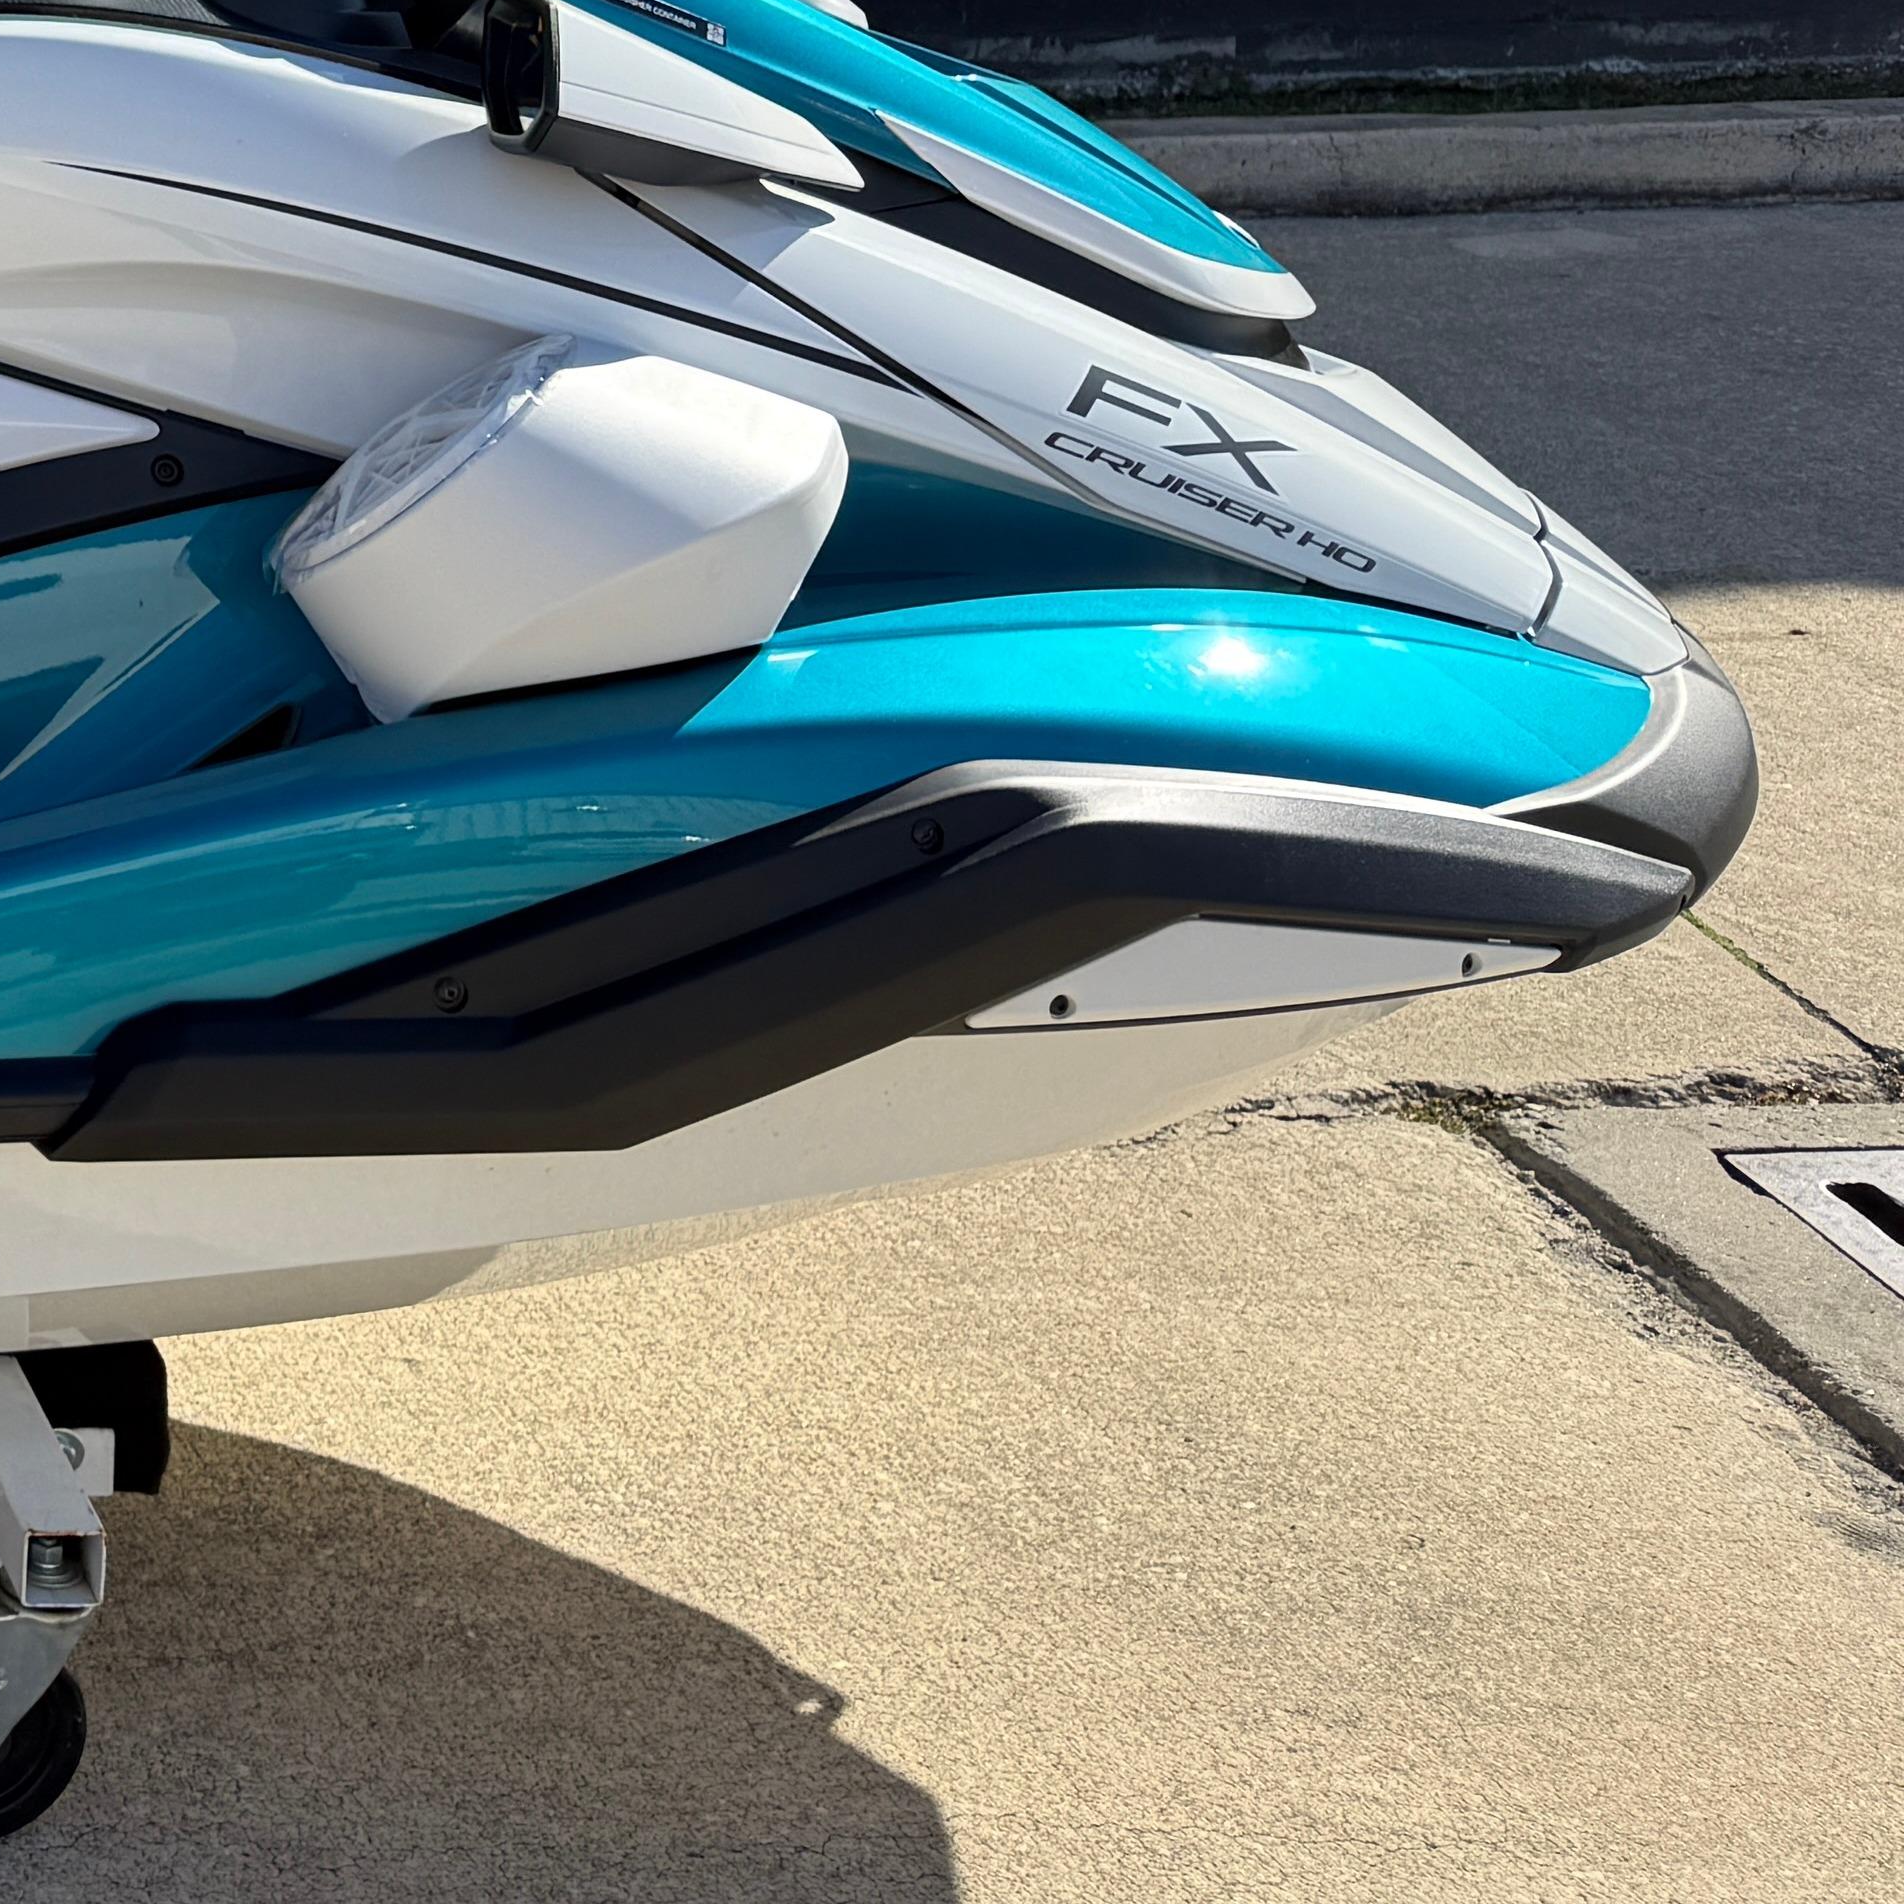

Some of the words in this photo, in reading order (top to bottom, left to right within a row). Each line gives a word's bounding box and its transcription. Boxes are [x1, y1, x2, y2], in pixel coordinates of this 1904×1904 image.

[1065, 364, 1298, 496] FX
[1043, 431, 1295, 539] CRUISER
[1294, 529, 1378, 574] HO
